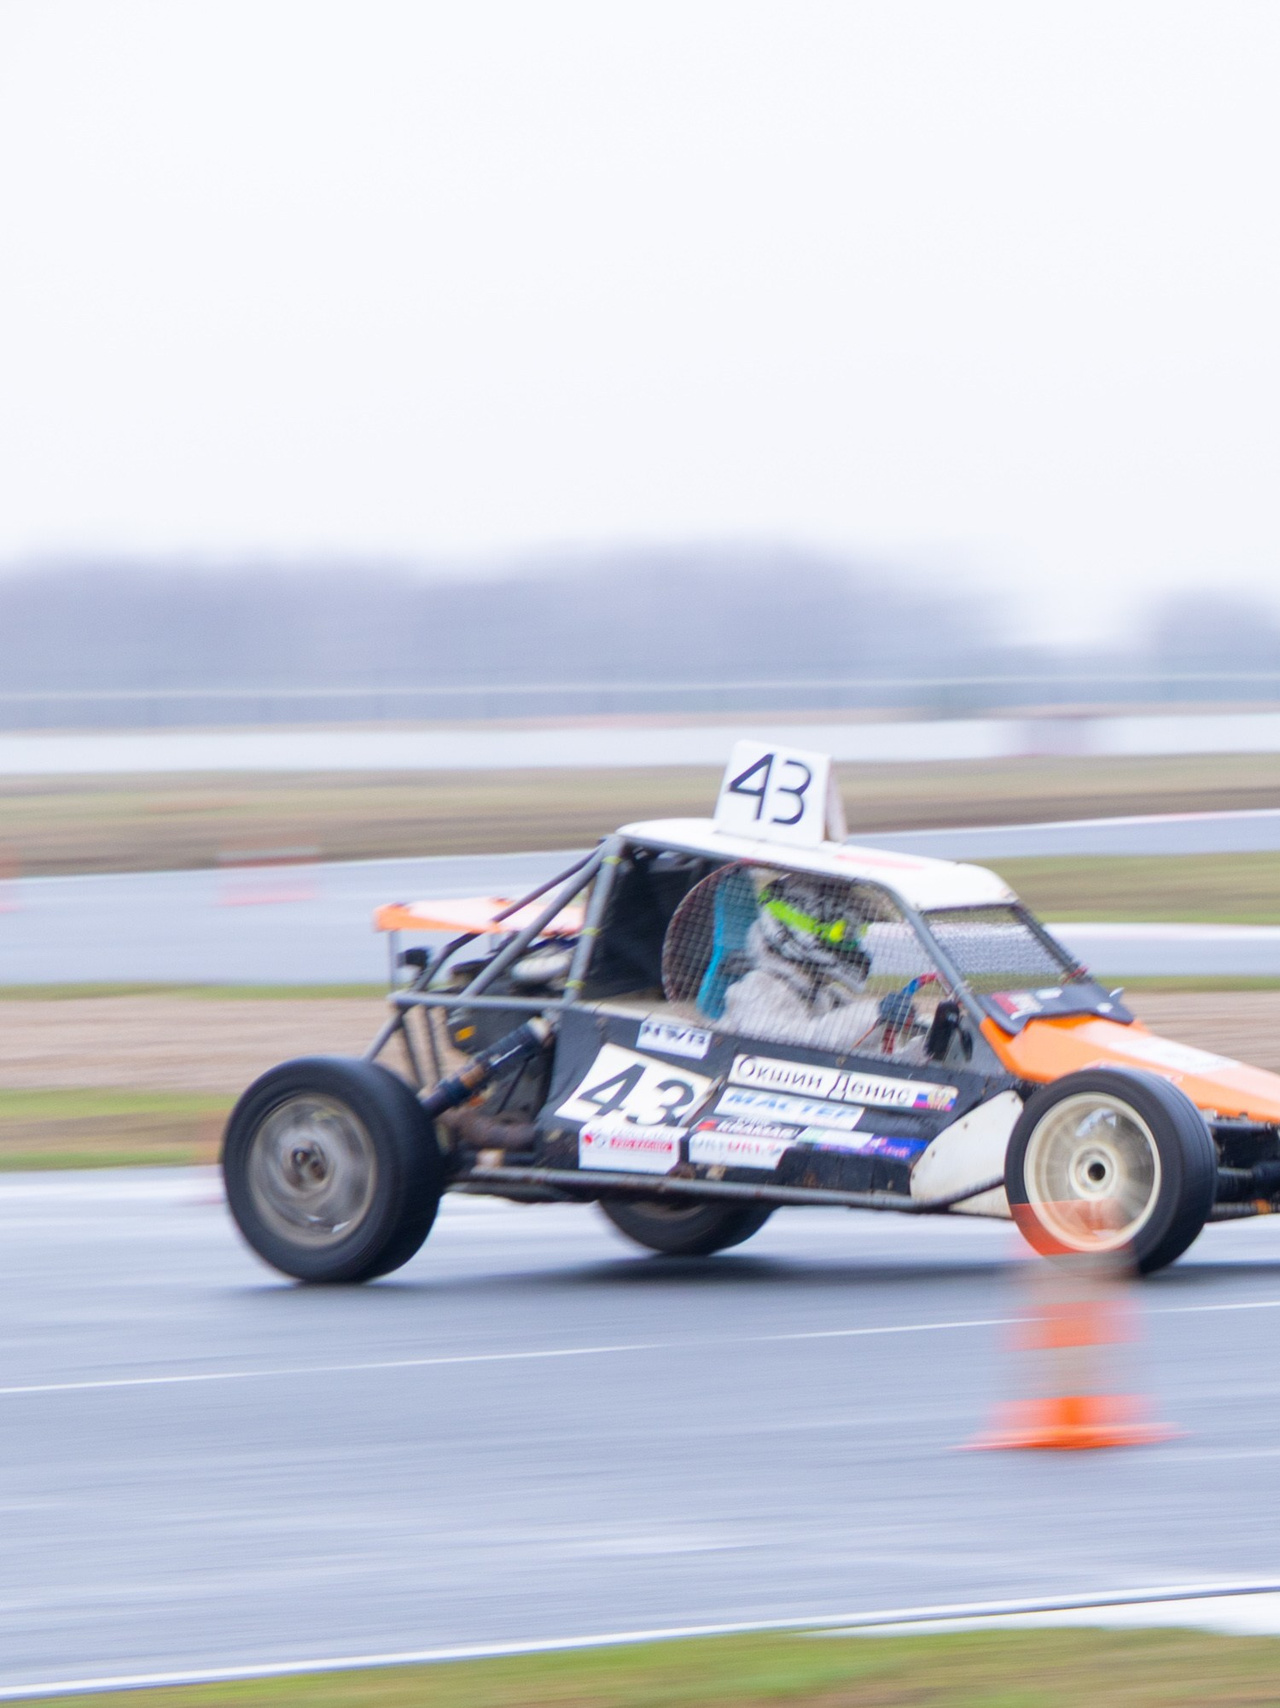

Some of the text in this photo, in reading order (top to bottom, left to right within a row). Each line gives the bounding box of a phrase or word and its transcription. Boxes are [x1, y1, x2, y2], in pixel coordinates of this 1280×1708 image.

[728, 752, 812, 825] 43
[577, 1063, 695, 1127] 43
[726, 1090, 859, 1120] МАСТЕР
[737, 1054, 912, 1105] Окшин Денис
